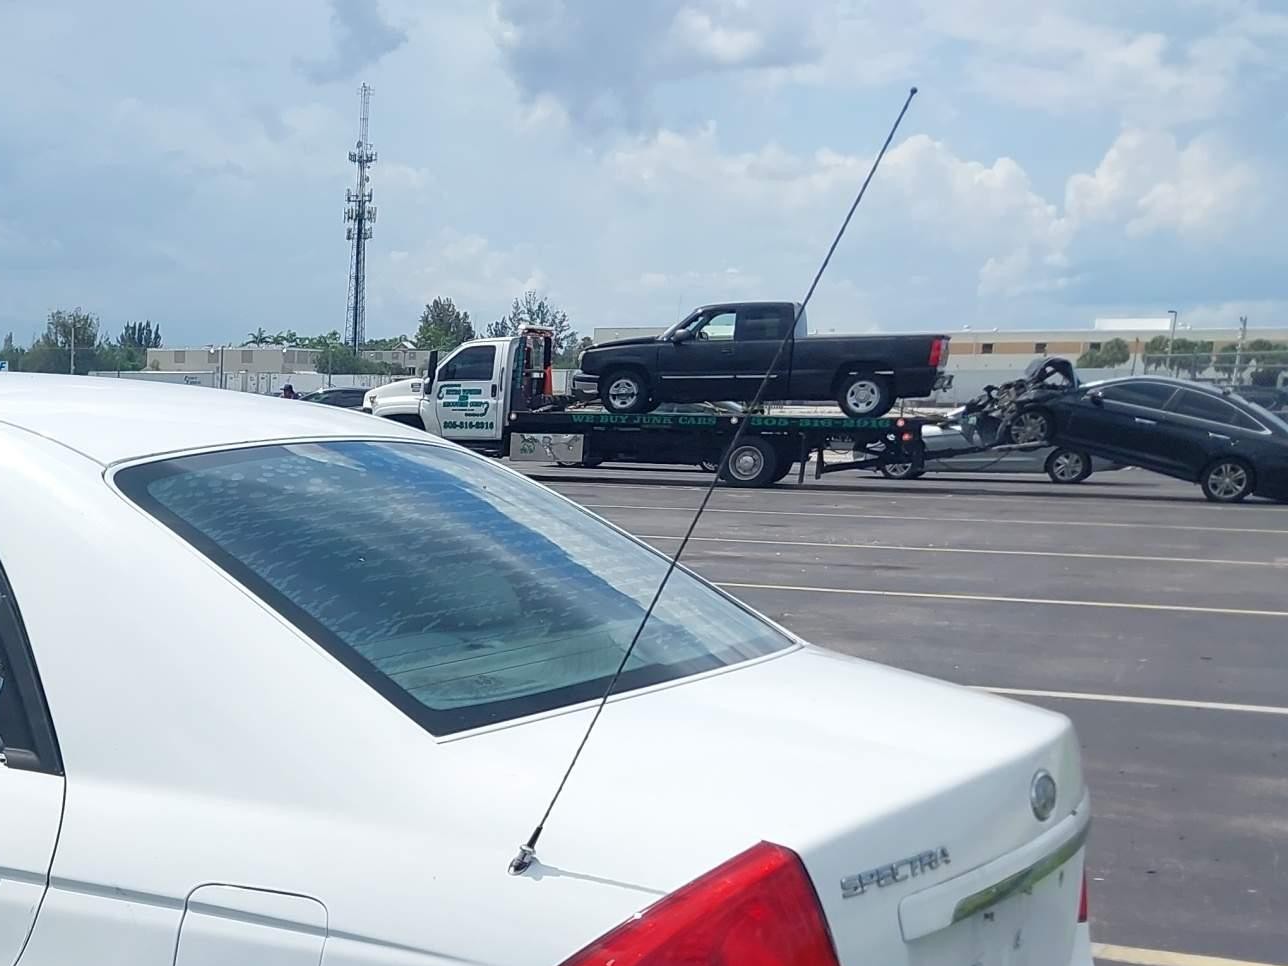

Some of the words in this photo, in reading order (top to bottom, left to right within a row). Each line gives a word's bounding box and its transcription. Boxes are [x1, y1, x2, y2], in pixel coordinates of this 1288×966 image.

[572, 414, 594, 423] WE
[599, 415, 628, 423] BUY
[633, 415, 672, 424] JUNK
[678, 416, 716, 425] CARS
[840, 846, 951, 899] SPECTRA
